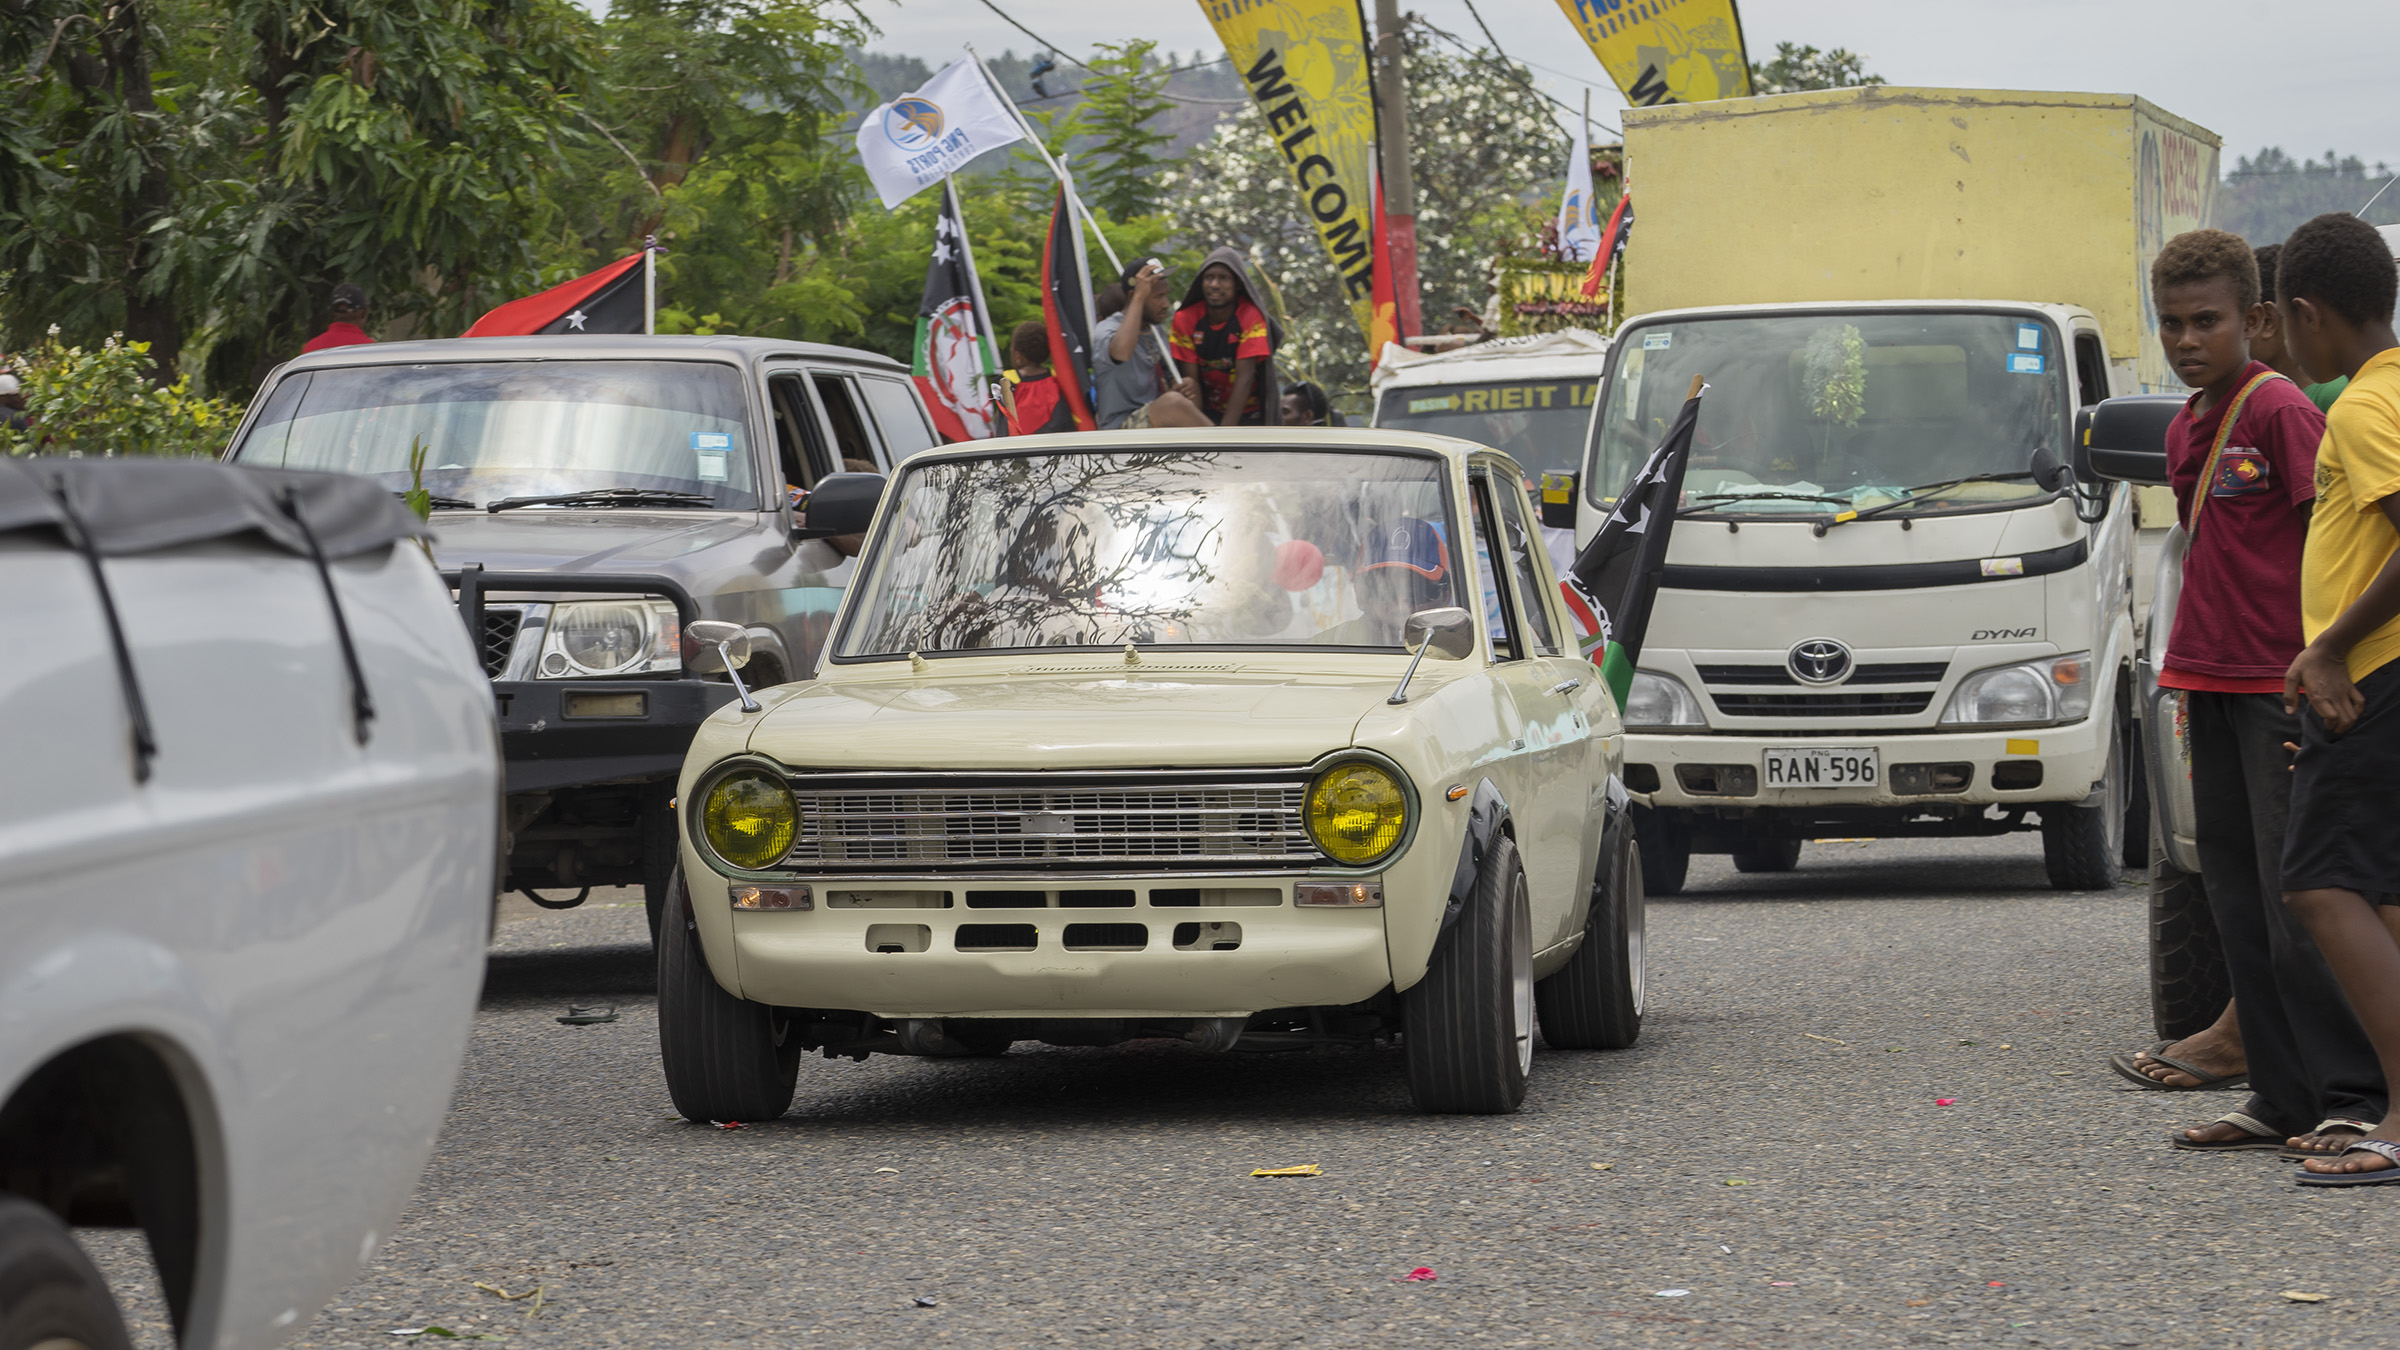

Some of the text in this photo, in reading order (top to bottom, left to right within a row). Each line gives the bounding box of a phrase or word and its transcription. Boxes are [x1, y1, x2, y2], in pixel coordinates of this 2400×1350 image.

[1246, 48, 1372, 301] WELCOME
[1464, 386, 1558, 412] RIEIT
[1971, 627, 2037, 640] DYNA
